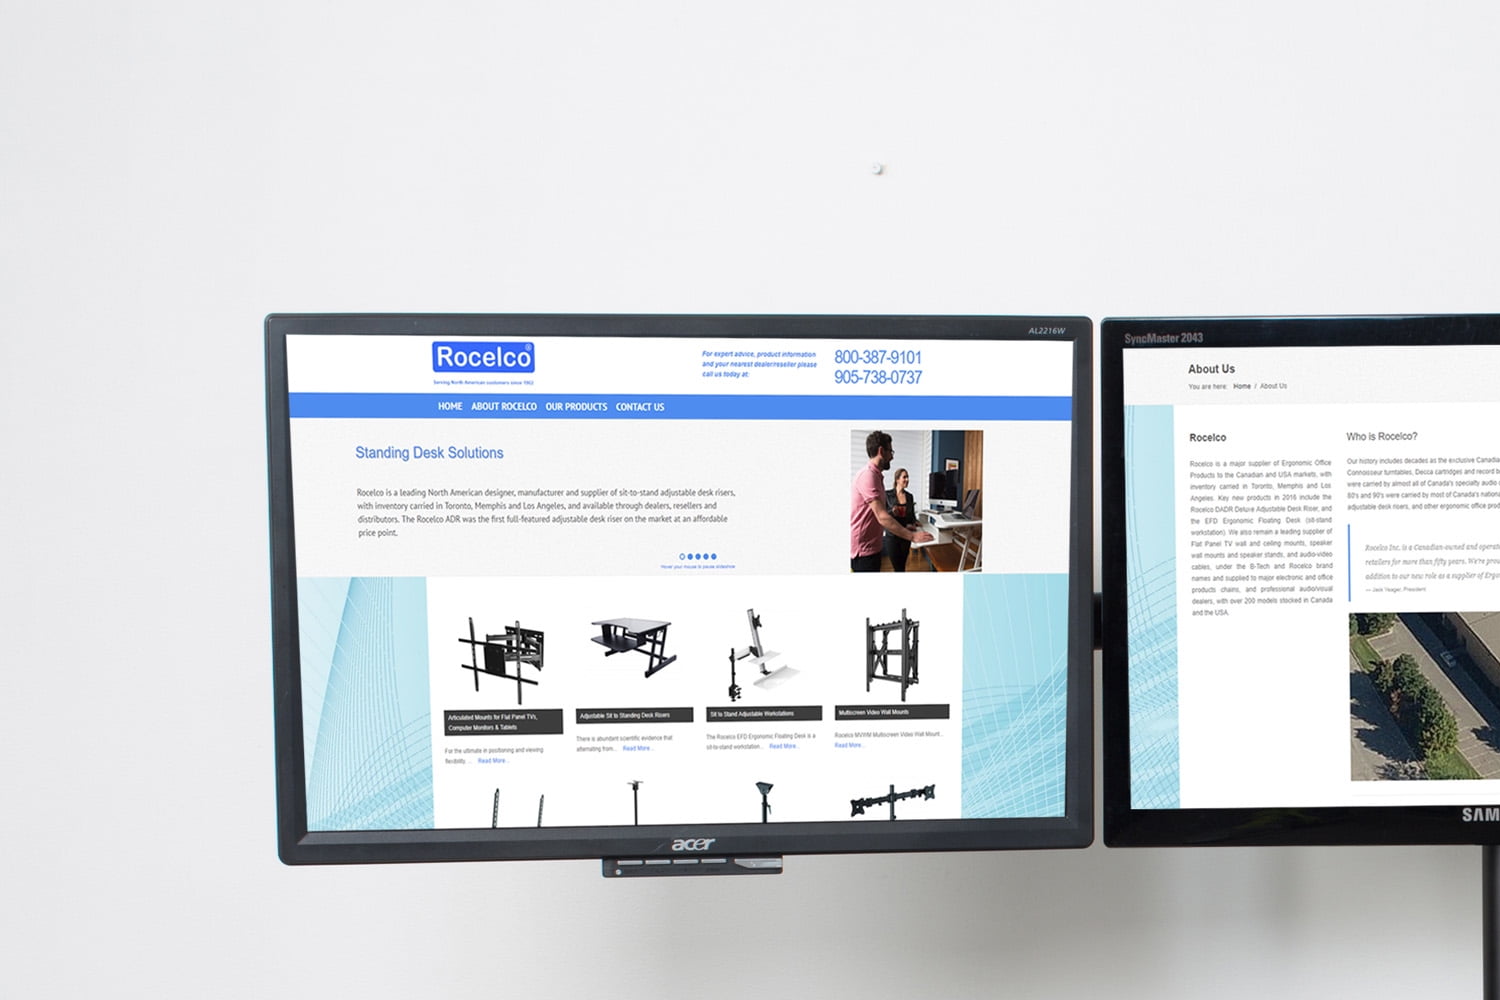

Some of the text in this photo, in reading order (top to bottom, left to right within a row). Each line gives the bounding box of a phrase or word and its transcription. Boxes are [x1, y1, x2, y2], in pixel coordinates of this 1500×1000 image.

[1125, 332, 1203, 346] SyncMaster 2043
[834, 349, 922, 364] 800-387-9101
[1189, 364, 1235, 374] About Us
[834, 369, 922, 384] 905-738-0737
[439, 402, 664, 411] HOME ABOUT ROCELCO OUR PRODUCTS CONTACT US
[1190, 433, 1226, 442] Rocelco
[1347, 432, 1418, 441] Who is Rocelco?
[356, 446, 503, 462] Standing Desk Solutions
[357, 488, 384, 496] Rocelco
[400, 489, 426, 499] leading
[450, 488, 483, 496] American
[485, 488, 516, 499] designer,
[518, 488, 563, 496] manufacturer
[581, 489, 608, 498] supplier
[619, 488, 659, 496] sit-to-stand
[660, 488, 696, 498] adjustable
[715, 488, 735, 496] risers,
[375, 502, 408, 511] inventory
[410, 502, 434, 510] carried
[445, 502, 473, 510] Toronto,
[475, 502, 506, 511] Memphis
[537, 502, 566, 512] Angeles,
[616, 502, 643, 512] through
[645, 502, 671, 510] dealers,
[358, 515, 399, 523] distributors.
[402, 515, 415, 523] The
[417, 515, 444, 523] Rocelco
[445, 515, 460, 523] ADR
[507, 515, 550, 523] full-featured
[552, 515, 588, 524] adjustable
[358, 529, 397, 538] price point.
[672, 838, 716, 851] acer
